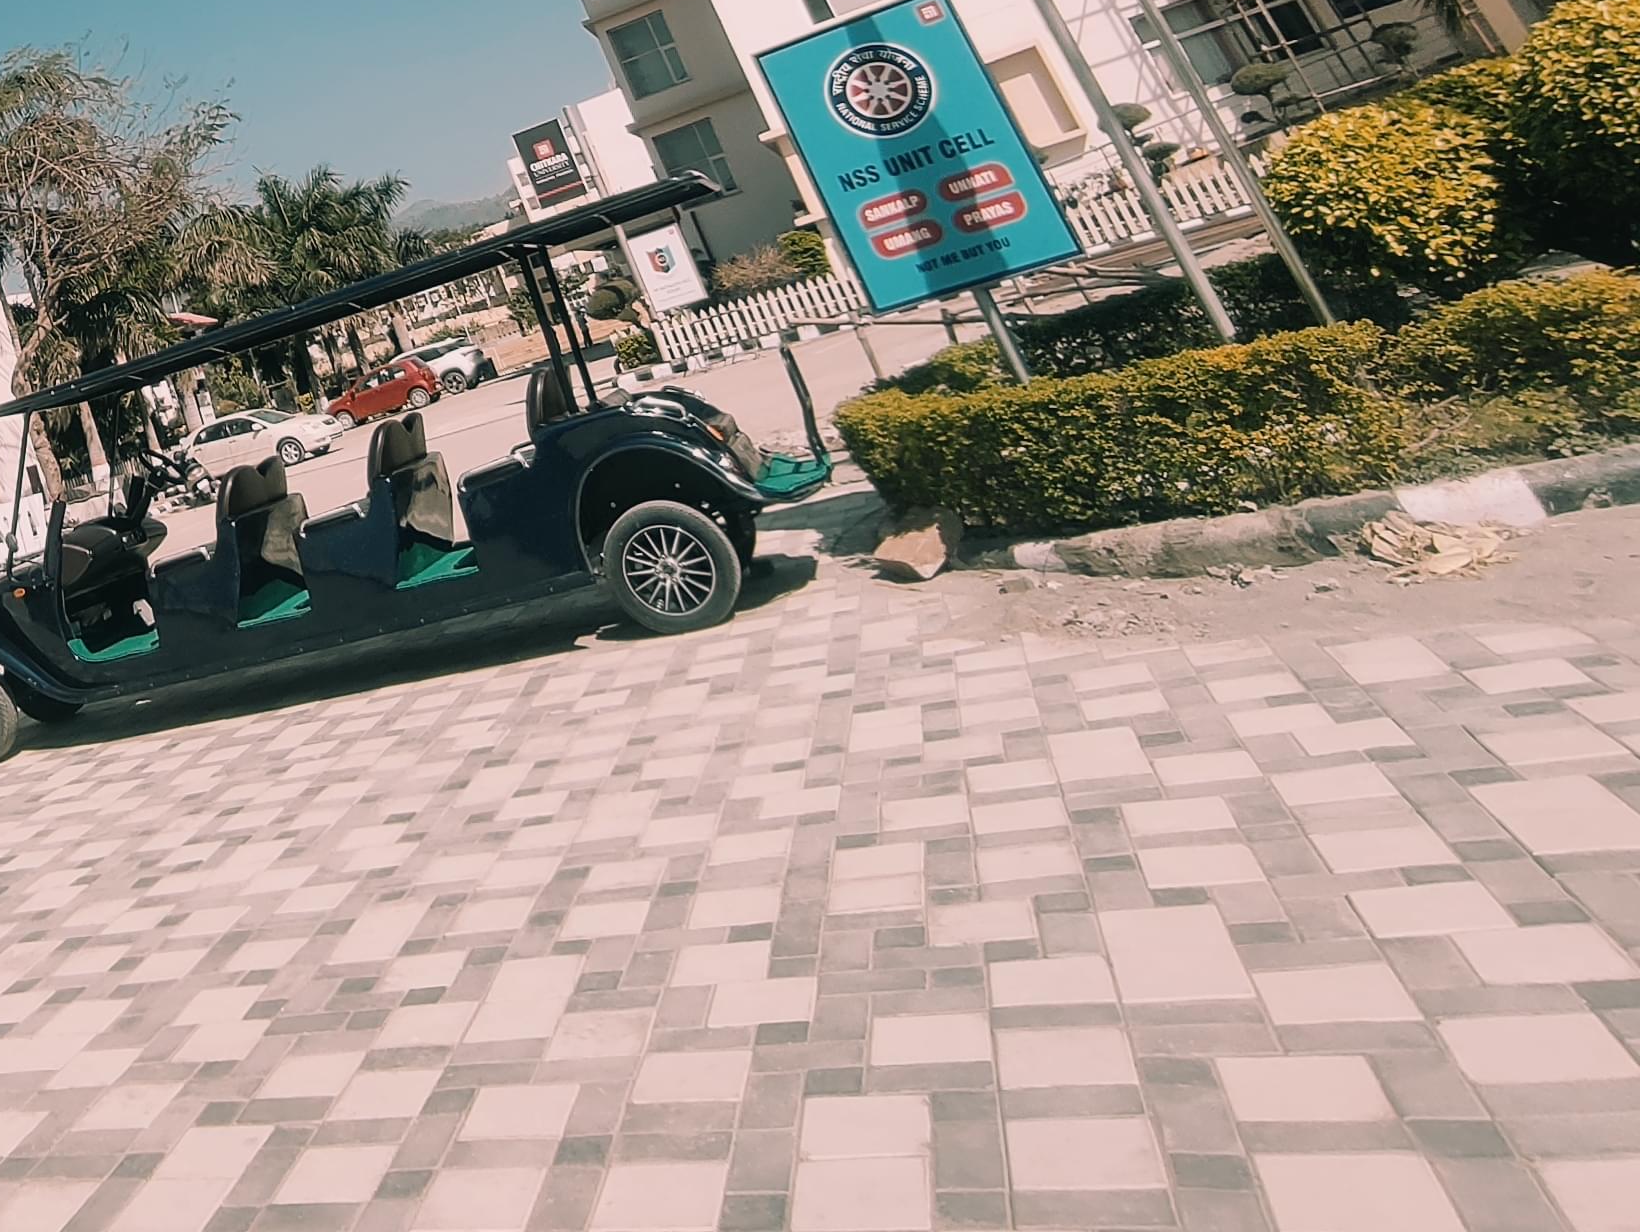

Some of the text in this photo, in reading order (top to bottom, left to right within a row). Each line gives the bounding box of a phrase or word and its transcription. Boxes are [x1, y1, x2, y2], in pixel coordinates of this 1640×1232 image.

[835, 74, 930, 132] NATIONAL SERVICE SCHEME
[533, 161, 570, 178] UNIVERSITY
[838, 128, 995, 192] NSS UNIT CELL
[948, 169, 997, 195] UNNATI
[864, 194, 920, 222] SANKALP
[963, 200, 1016, 226] PRAYAS
[882, 227, 932, 252] UMANG
[916, 237, 1011, 273] NOT ME BUT YOU
